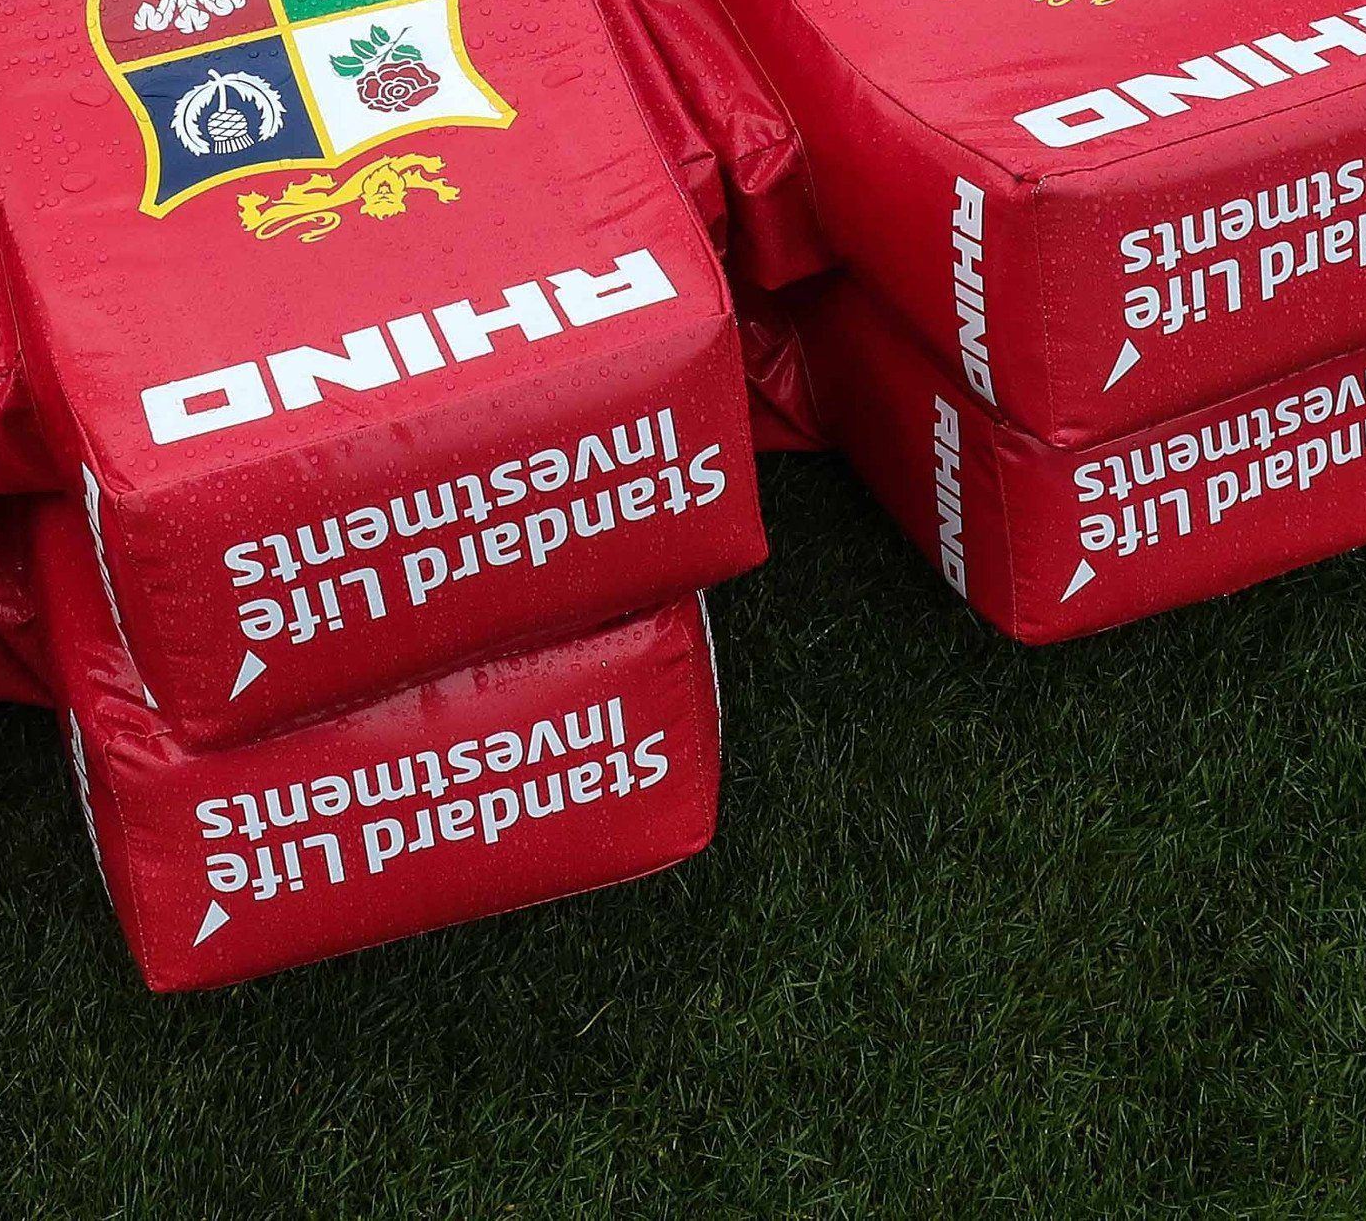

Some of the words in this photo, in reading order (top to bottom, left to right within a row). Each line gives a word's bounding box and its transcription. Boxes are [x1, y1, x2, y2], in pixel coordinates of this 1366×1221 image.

[140, 247, 679, 446] RHINO
[952, 175, 999, 408] RHINO
[1123, 257, 1242, 335] Life
[223, 407, 679, 588] Investments
[403, 444, 728, 606] Standard
[933, 394, 967, 600] RHINO
[1079, 487, 1192, 558] Life
[237, 567, 388, 646] Life
[192, 696, 627, 842] Investments
[364, 730, 670, 872] Standard
[205, 831, 347, 901] Life
